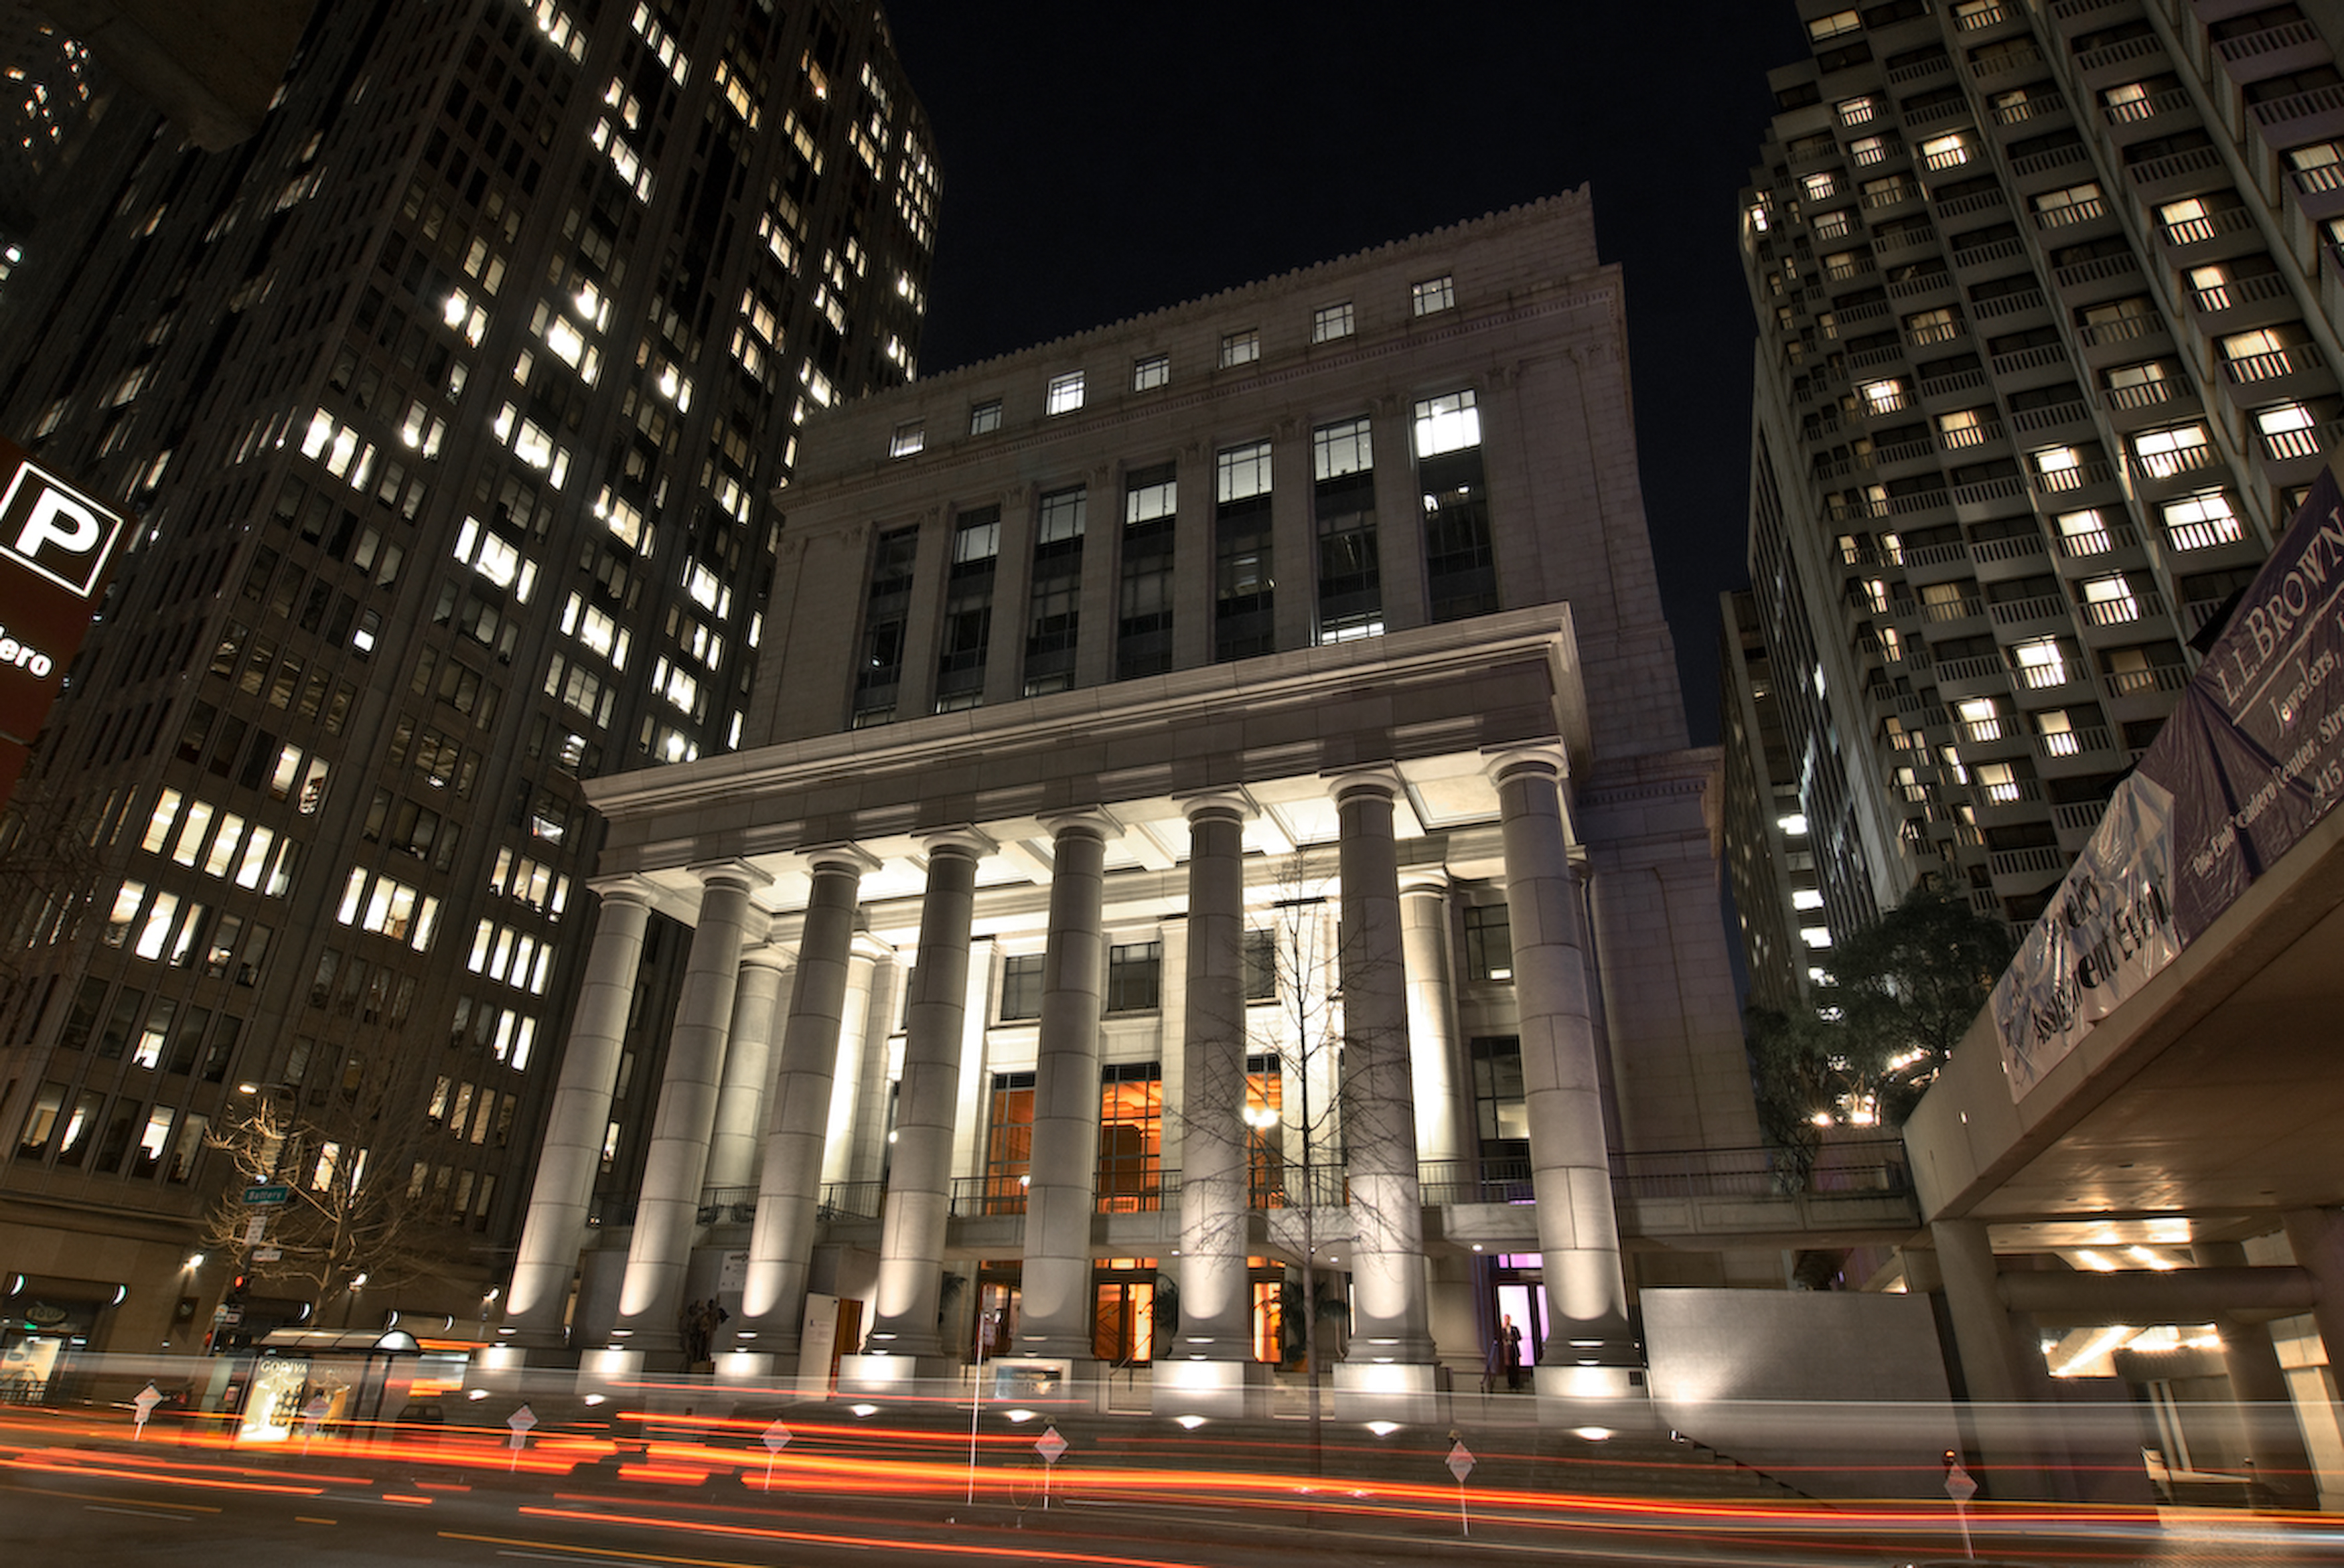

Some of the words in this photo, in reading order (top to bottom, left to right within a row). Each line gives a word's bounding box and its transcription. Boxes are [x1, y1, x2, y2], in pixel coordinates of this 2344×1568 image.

[15, 487, 100, 557] P
[0, 625, 52, 677] ero
[2314, 759, 2343, 799] 415
[260, 1360, 308, 1373] GODIVA
